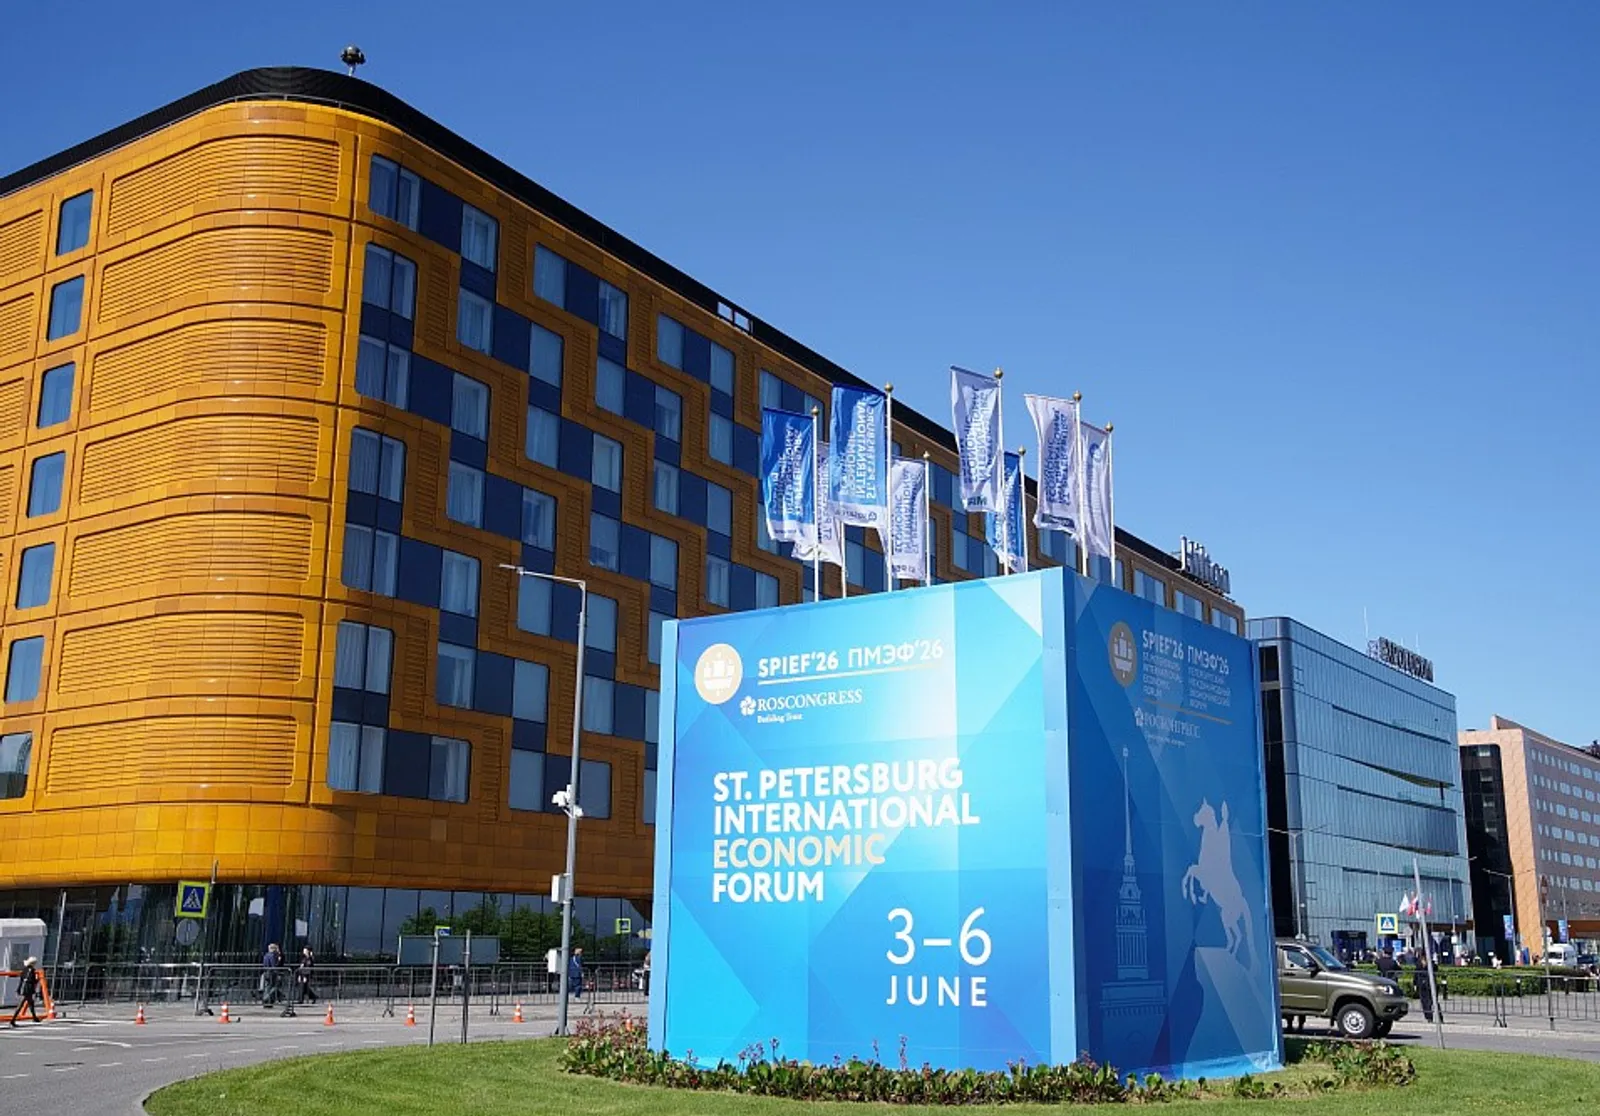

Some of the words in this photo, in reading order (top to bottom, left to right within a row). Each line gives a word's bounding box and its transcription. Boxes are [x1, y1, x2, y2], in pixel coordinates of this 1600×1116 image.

[757, 688, 863, 713] ROSCONGRESS
[713, 771, 752, 802] ST.
[759, 757, 963, 800] PETERSBURG
[714, 793, 980, 836] INTERNATIONAL
[713, 833, 886, 869] ECONOMIC
[712, 871, 824, 903] FORUM
[886, 975, 988, 1007] JUNE
